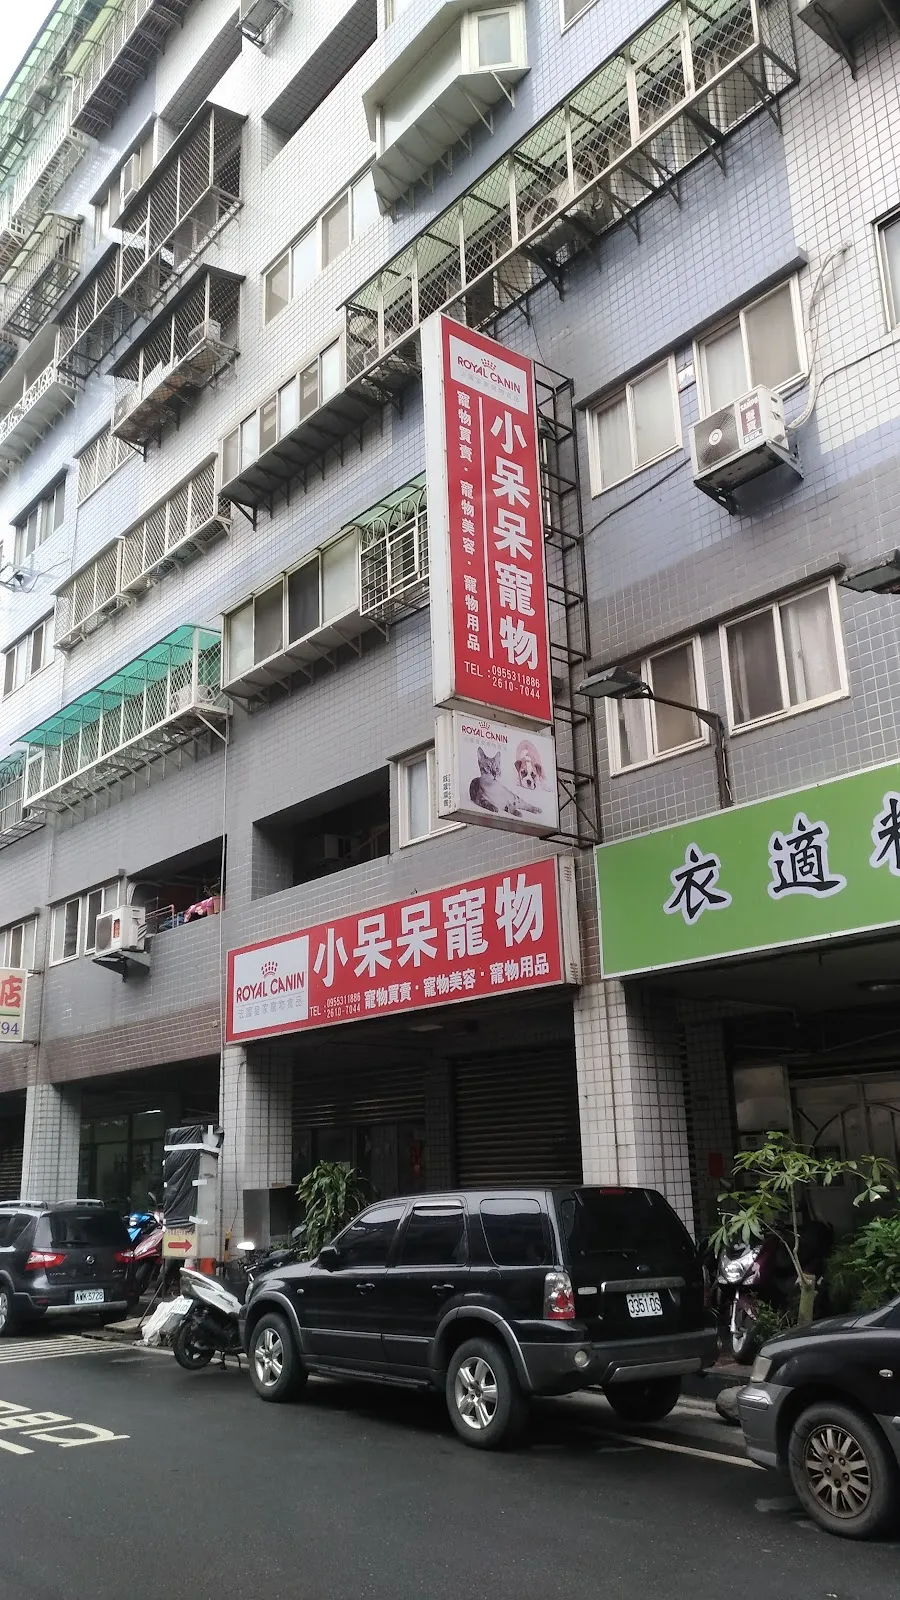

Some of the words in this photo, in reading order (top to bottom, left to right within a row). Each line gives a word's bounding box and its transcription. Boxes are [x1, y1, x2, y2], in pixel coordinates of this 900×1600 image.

[457, 356, 488, 378] ROYAL
[490, 372, 521, 394] CANIN
[490, 409, 539, 670] 小呆呆寵物
[491, 665, 540, 689] 0955311886
[492, 677, 541, 699] 2610-7044
[461, 724, 484, 738] ROYAL
[485, 731, 508, 743] CANIN
[313, 873, 544, 988] 小呆呆寵物
[0, 974, 23, 1008] 店
[236, 981, 268, 1003] ROYAL
[270, 971, 305, 995] CANIN
[326, 992, 361, 1008] 0955311886
[326, 1003, 361, 1018] 2610-7044
[0, 1021, 19, 1036] 94
